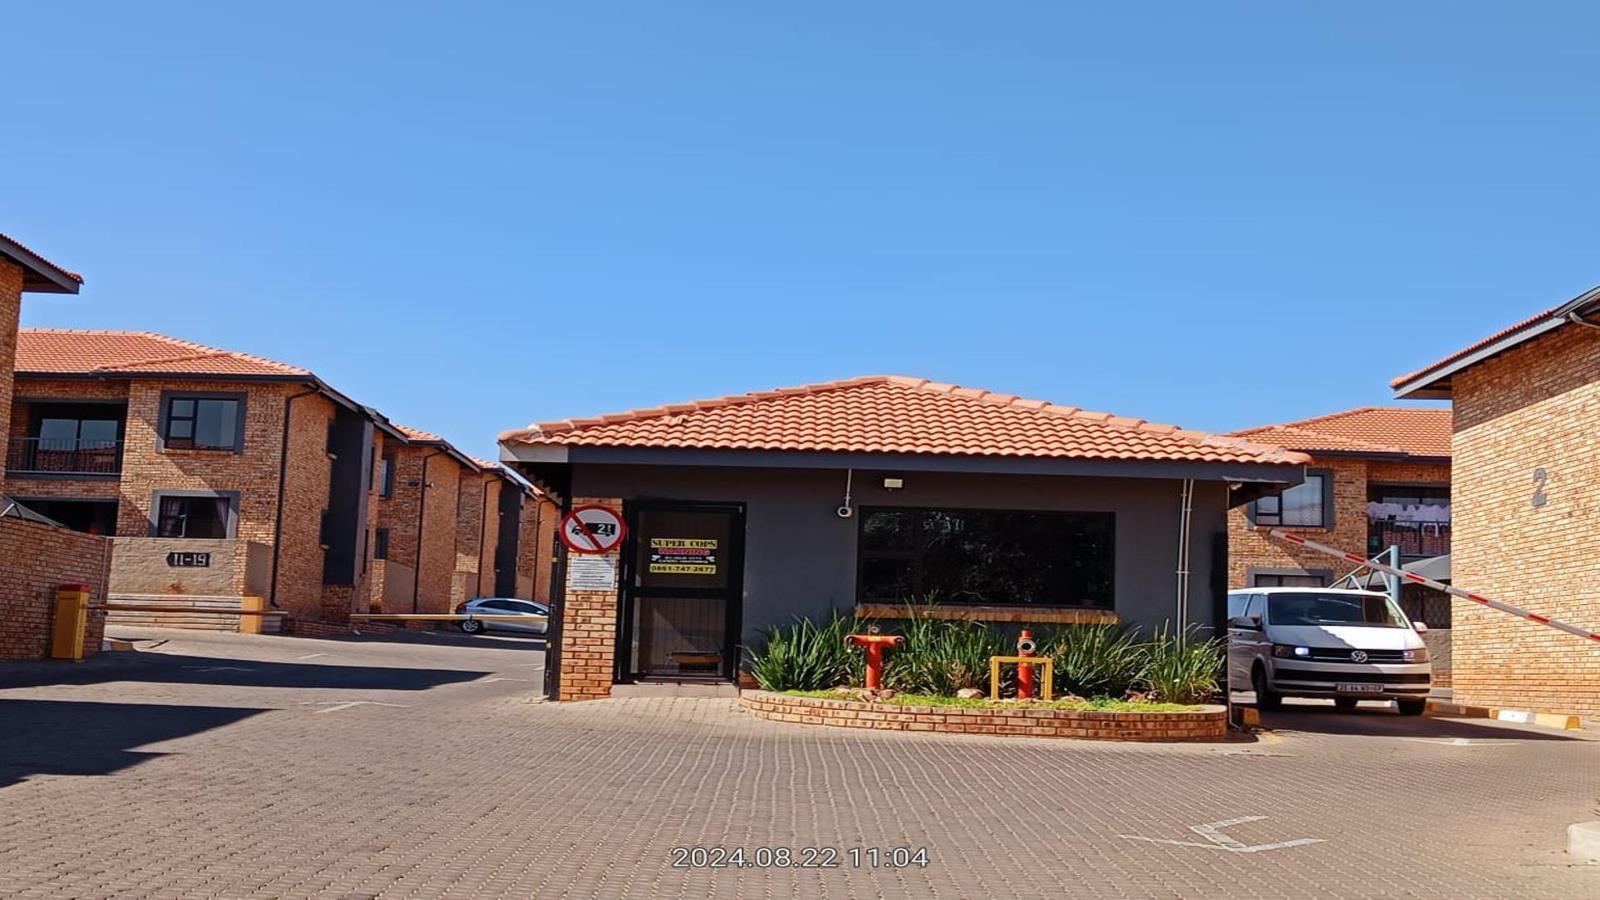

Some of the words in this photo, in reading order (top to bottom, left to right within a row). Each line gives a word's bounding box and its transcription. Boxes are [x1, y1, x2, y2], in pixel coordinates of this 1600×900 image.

[1532, 467, 1547, 507] 2
[689, 540, 716, 548] COPS
[174, 553, 207, 566] 11-19
